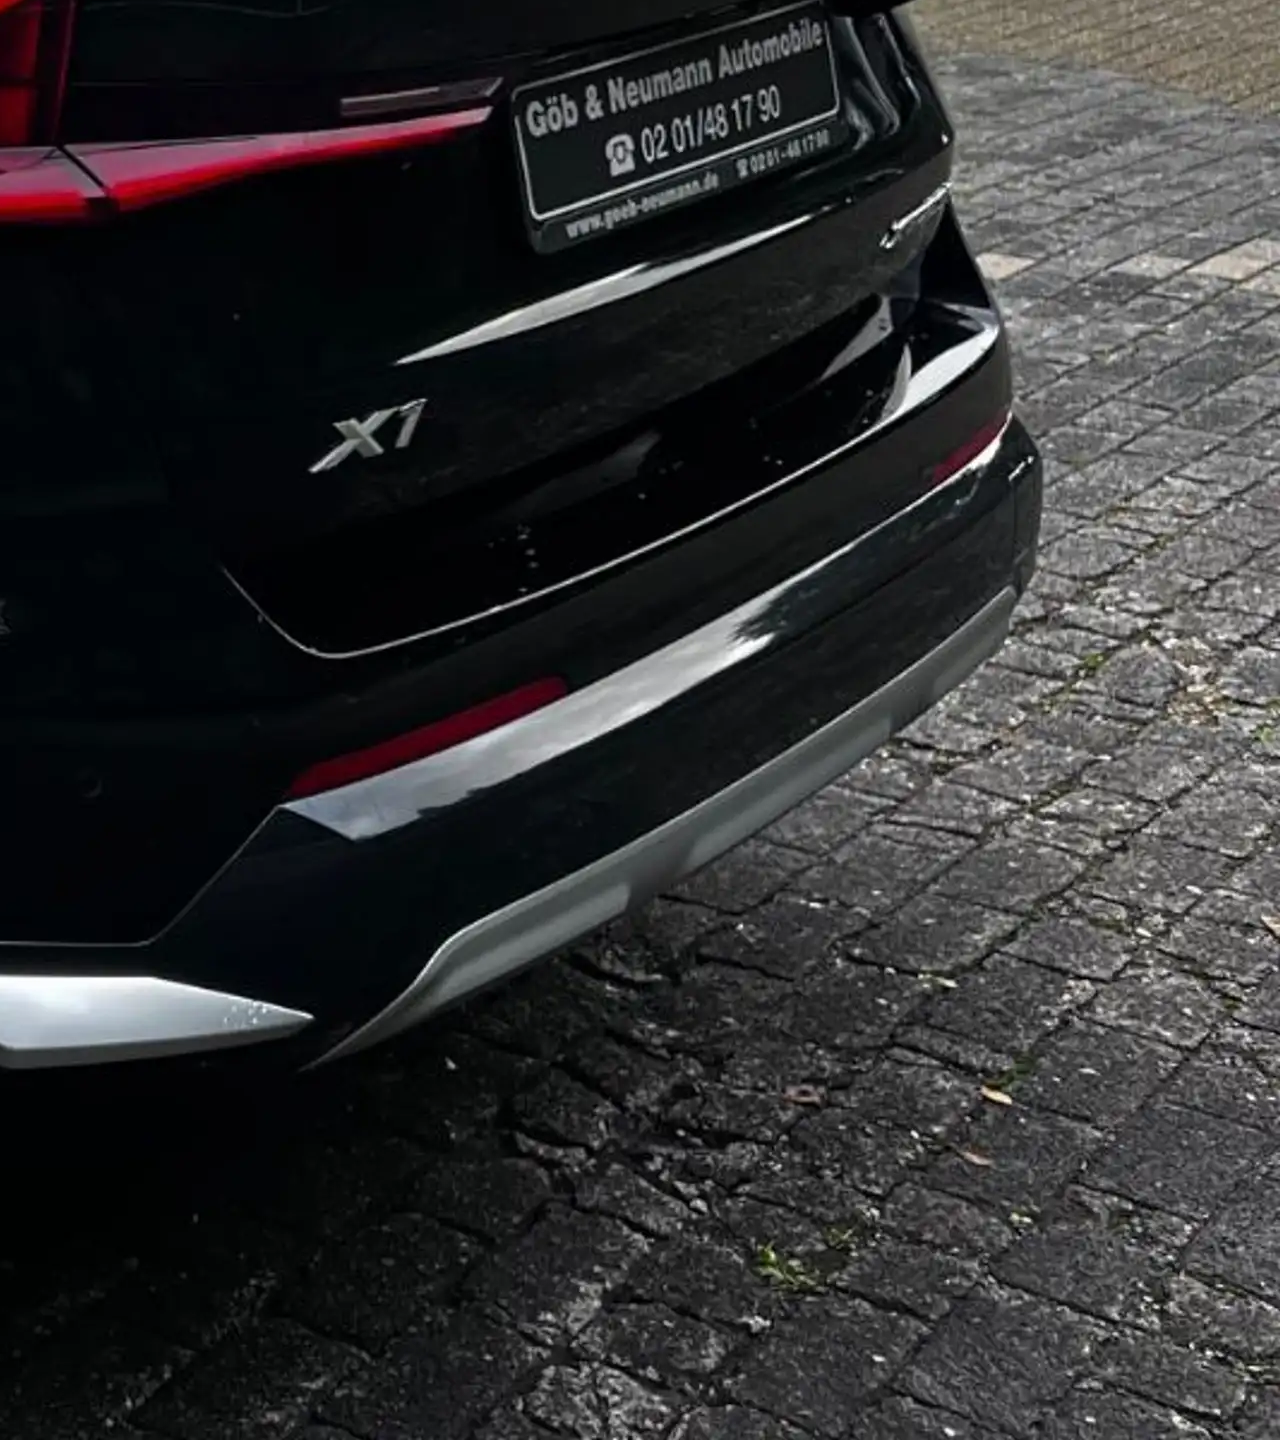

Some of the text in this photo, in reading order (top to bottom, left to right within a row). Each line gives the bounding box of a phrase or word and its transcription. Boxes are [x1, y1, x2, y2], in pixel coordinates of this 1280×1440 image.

[525, 16, 824, 138] Göb & Neumann Automobile
[640, 83, 782, 165] 02 01/48 17 90
[308, 397, 429, 474] X1
